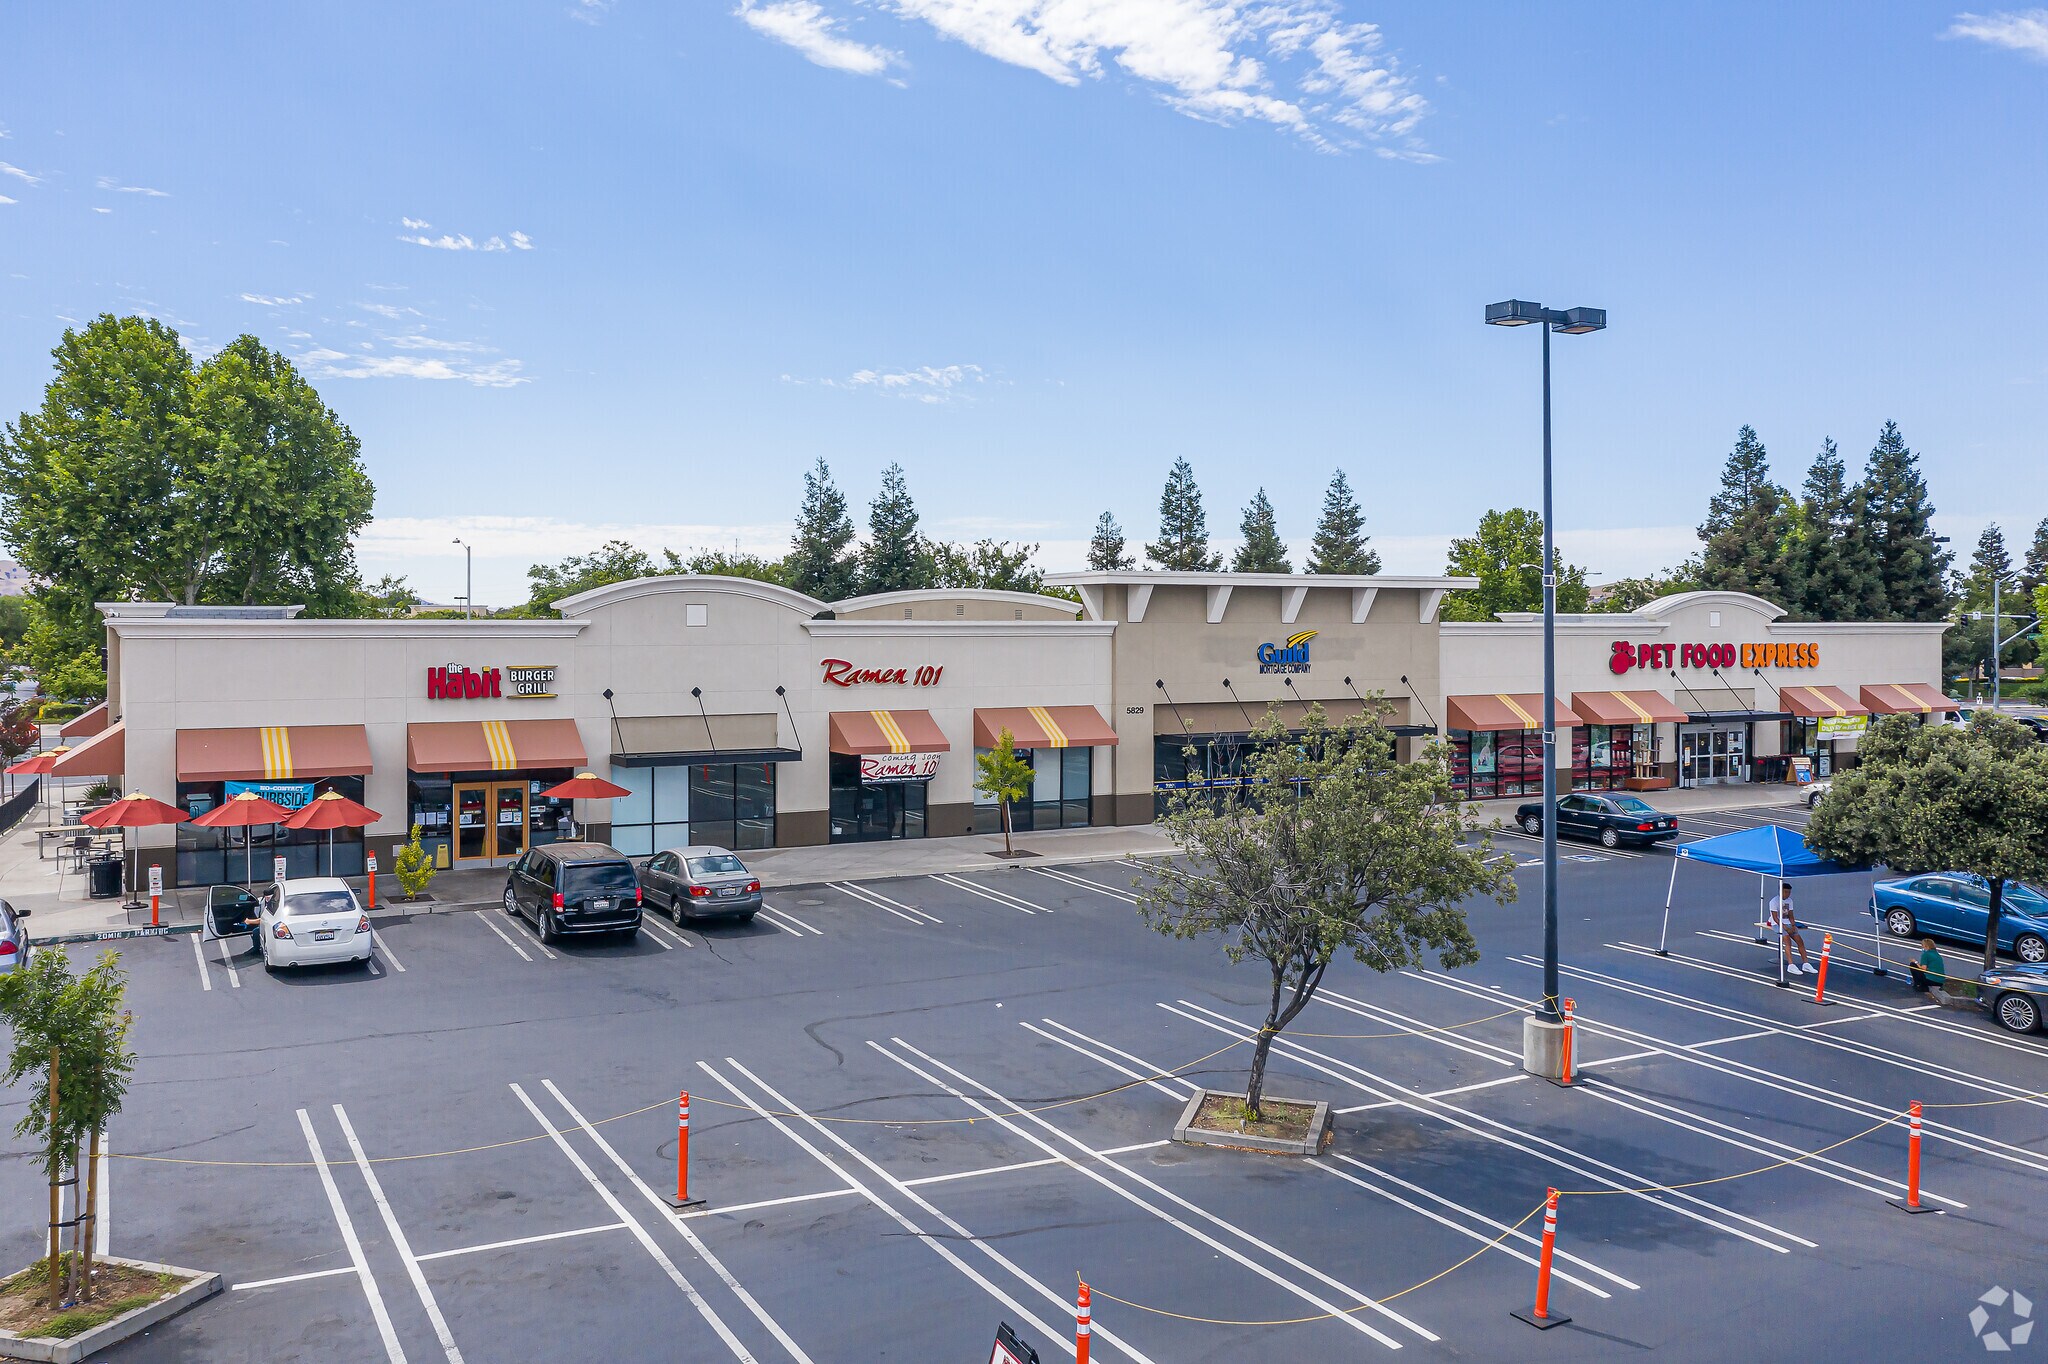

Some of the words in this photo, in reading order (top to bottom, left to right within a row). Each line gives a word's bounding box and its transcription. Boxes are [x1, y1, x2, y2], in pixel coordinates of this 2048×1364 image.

[1257, 643, 1310, 664] Guild
[1638, 643, 1676, 669] PET
[1681, 643, 1736, 669] FOOD
[1741, 643, 1820, 668] EXPRESS
[448, 662, 463, 674] the
[820, 658, 909, 688] Ramen
[912, 665, 944, 687] 101
[1259, 664, 1287, 674] MORTGAGE
[1288, 664, 1311, 673] COMPANY
[427, 666, 501, 699] Habit
[510, 670, 555, 682] BURGER
[517, 682, 548, 694] GRILL
[1126, 706, 1145, 715] 5829
[882, 753, 917, 766] coming
[922, 753, 941, 761] soon
[860, 759, 917, 778] Ramen
